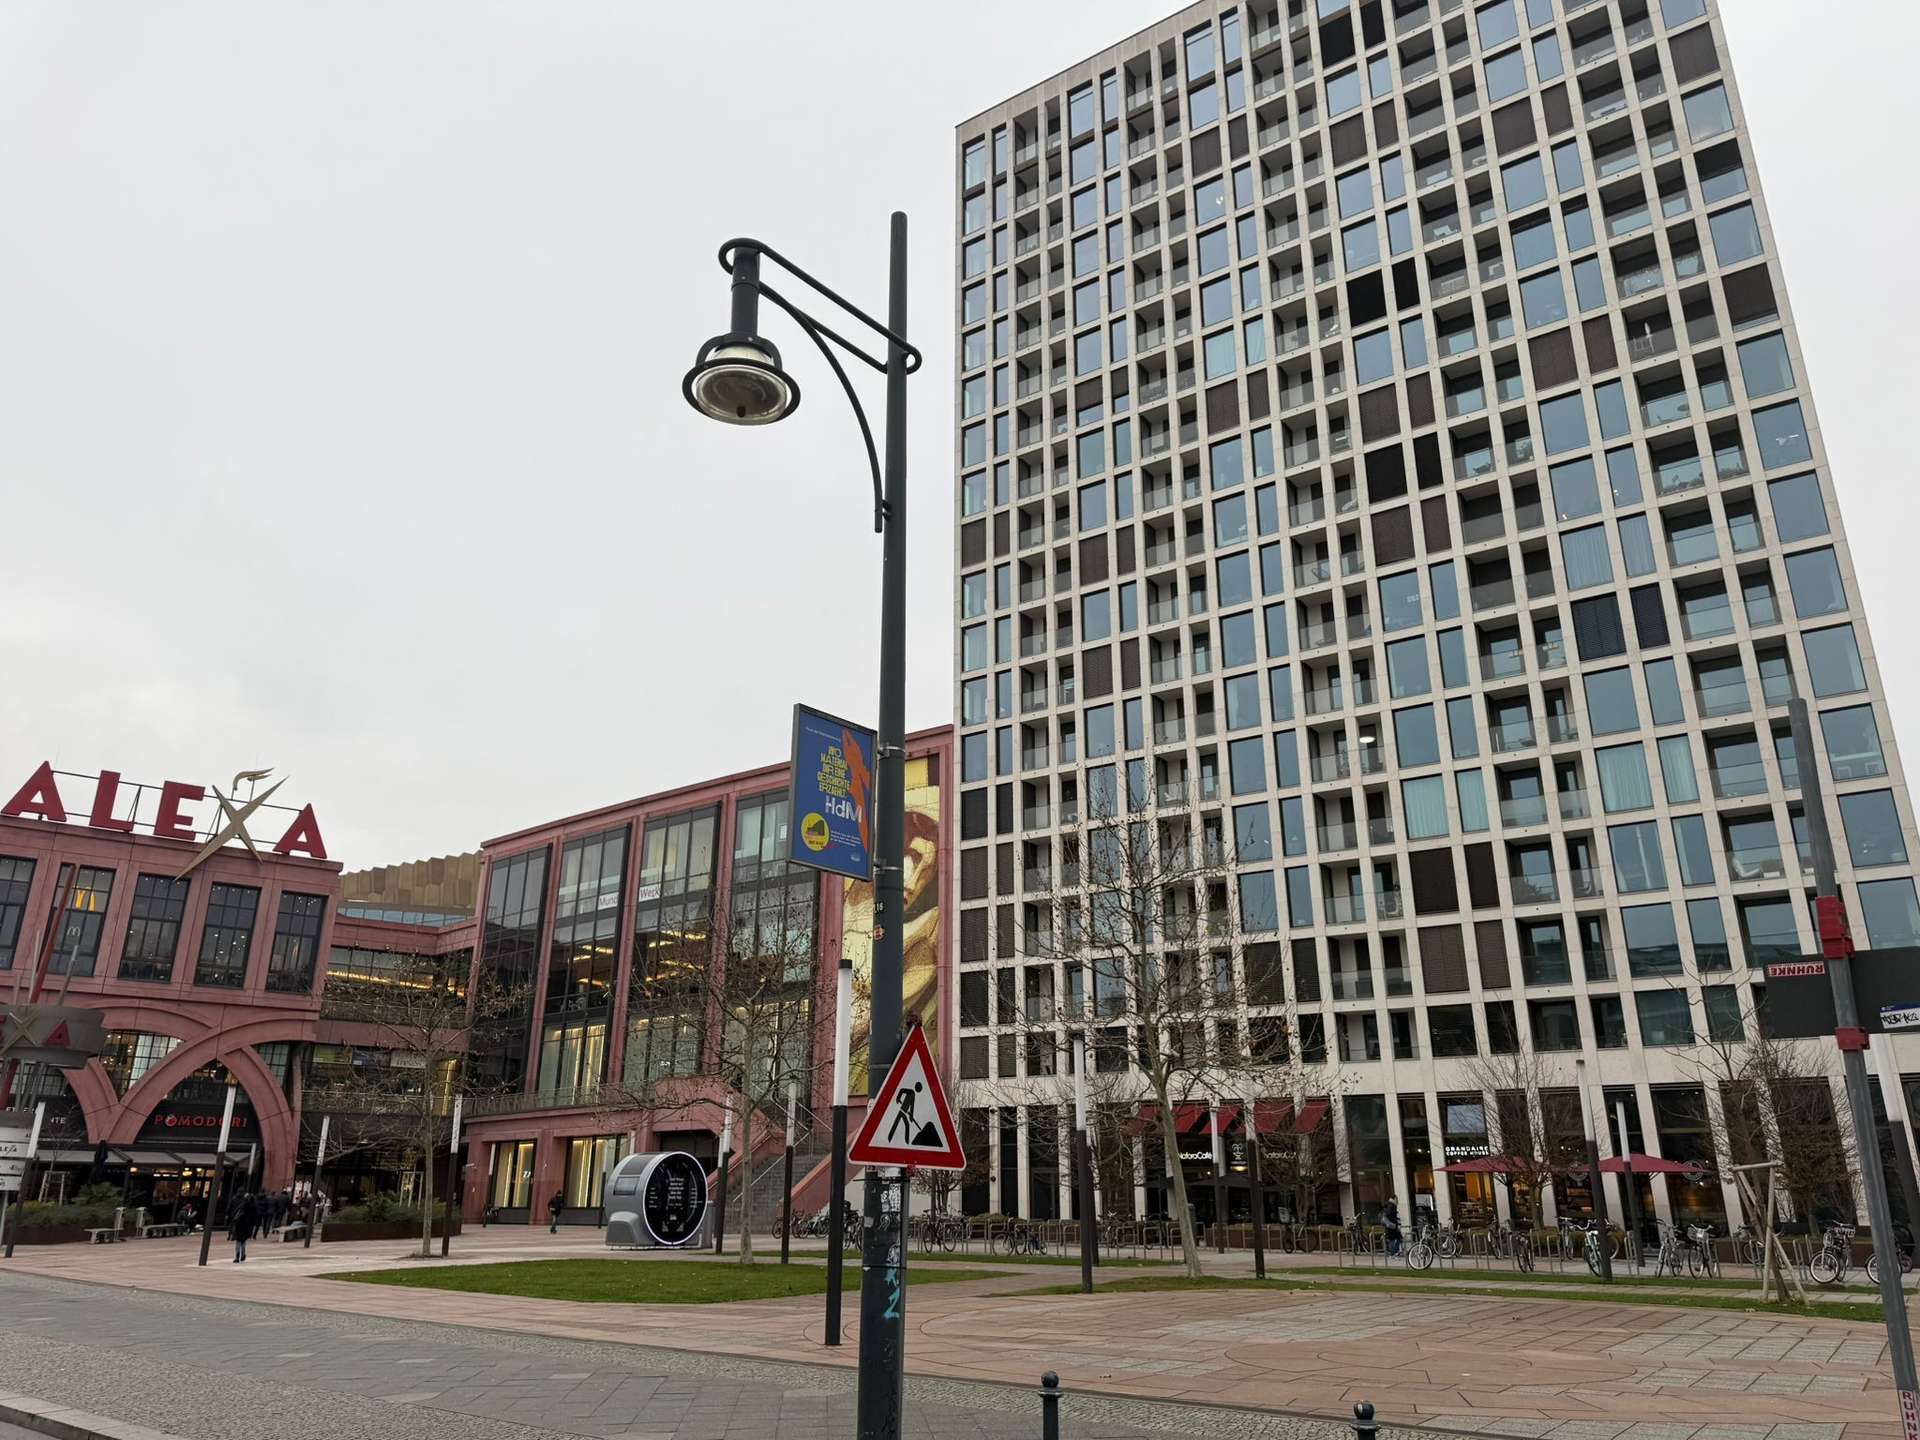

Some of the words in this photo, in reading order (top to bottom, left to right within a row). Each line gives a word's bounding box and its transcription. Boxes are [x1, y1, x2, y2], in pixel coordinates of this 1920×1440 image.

[825, 794, 862, 823] HdM
[1, 760, 327, 880] ALEXA
[1770, 964, 1824, 976] RUHNKE
[154, 1114, 247, 1128] POMODRI
